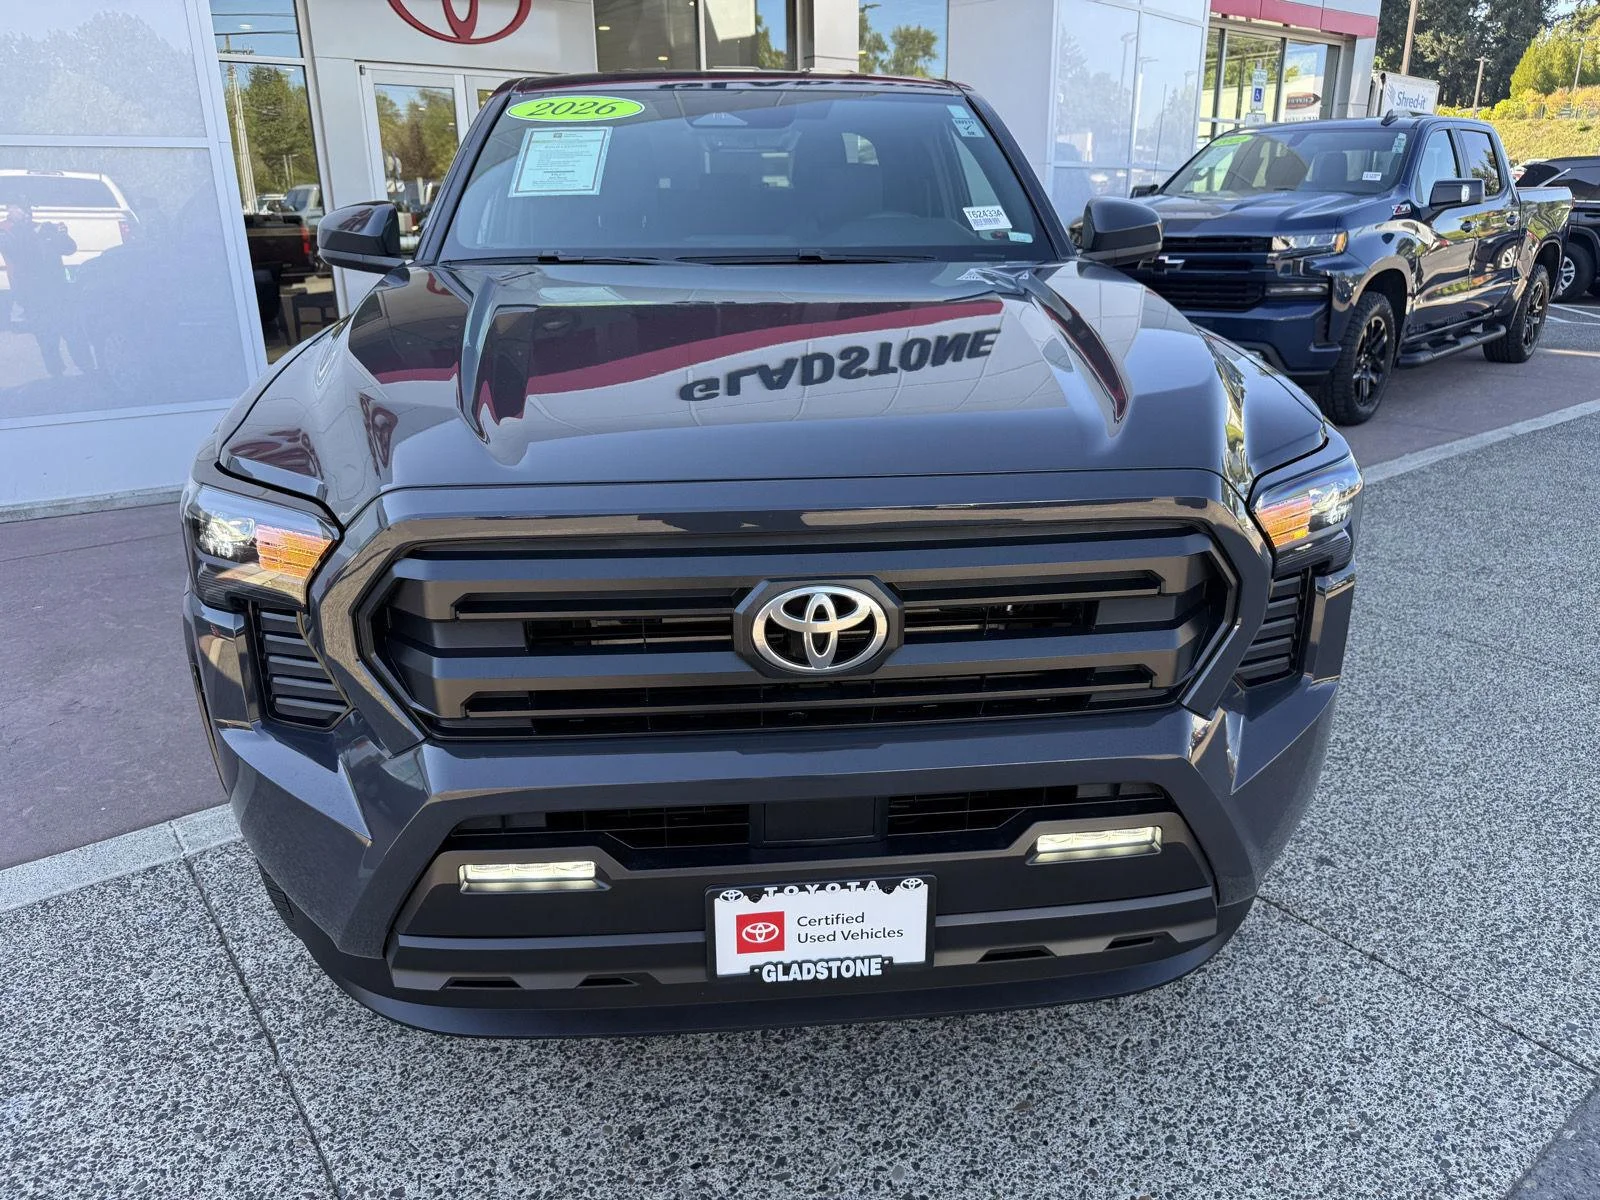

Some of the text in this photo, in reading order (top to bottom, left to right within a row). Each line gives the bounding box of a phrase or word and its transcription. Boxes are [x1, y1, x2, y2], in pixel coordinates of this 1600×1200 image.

[526, 101, 624, 117] 2026
[1396, 91, 1425, 110] Shred-it
[966, 209, 1003, 219] T62433A
[764, 880, 881, 898] TOYOTA
[797, 911, 865, 927] Certified
[797, 926, 904, 944] Used Vehicles
[762, 957, 883, 983] GLADSTONE
